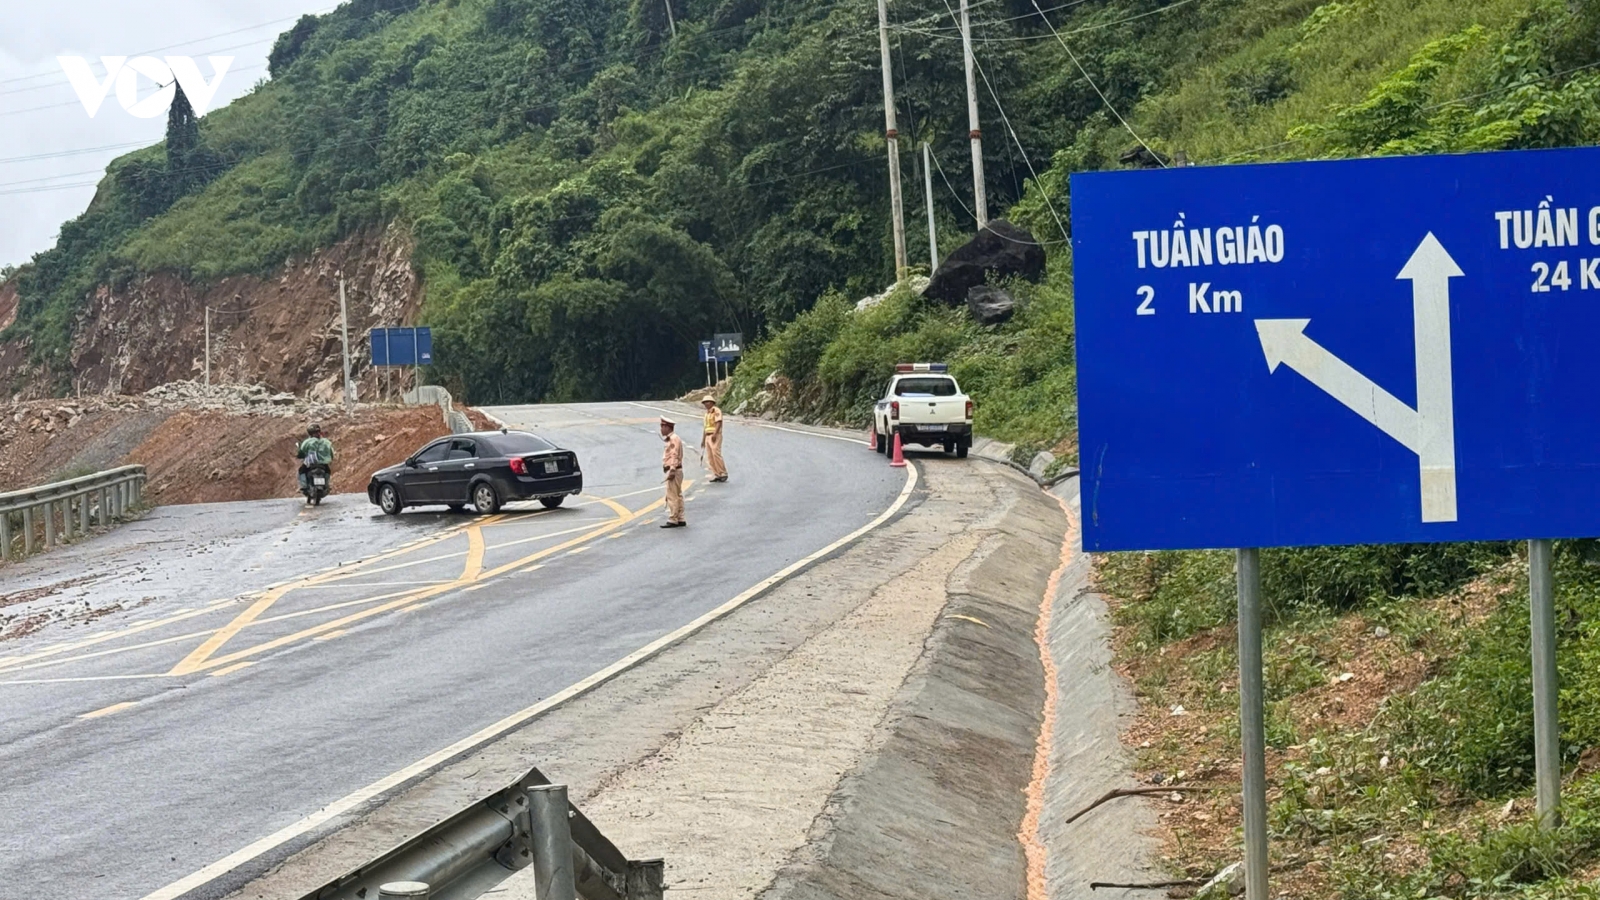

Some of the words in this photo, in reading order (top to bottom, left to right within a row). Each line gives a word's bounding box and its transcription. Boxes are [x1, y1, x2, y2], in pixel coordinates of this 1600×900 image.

[1132, 212, 1213, 269] TUẦN
[1215, 215, 1285, 266] GIÁO
[1494, 195, 1579, 249] TUẦN
[1530, 260, 1572, 293] 24
[1136, 285, 1156, 316] 2
[1189, 282, 1242, 314] Km
